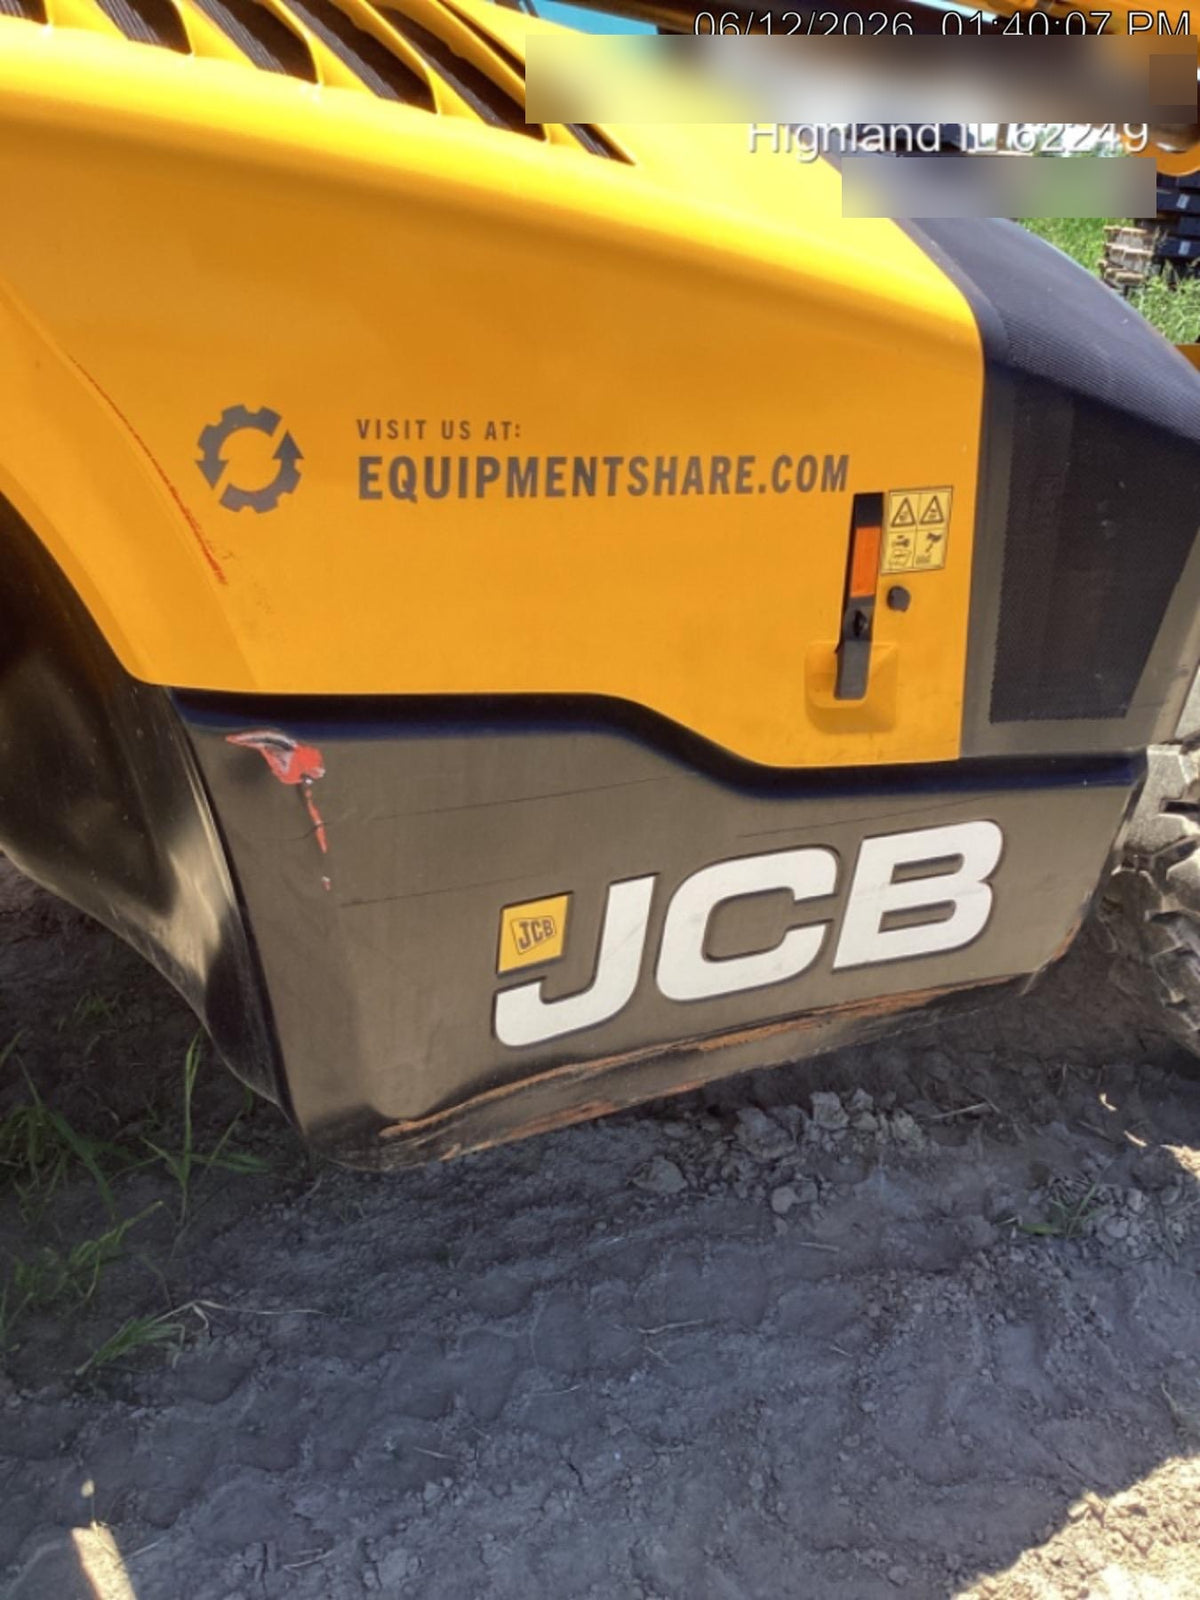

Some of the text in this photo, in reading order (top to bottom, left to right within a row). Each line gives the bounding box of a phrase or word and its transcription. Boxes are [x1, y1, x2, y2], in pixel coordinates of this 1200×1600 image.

[357, 418, 521, 441] VISIT US AT:
[358, 454, 850, 504] EQUIPMENTSHARE.COM
[494, 820, 1004, 1047] JCB
[518, 919, 554, 950] JCB
